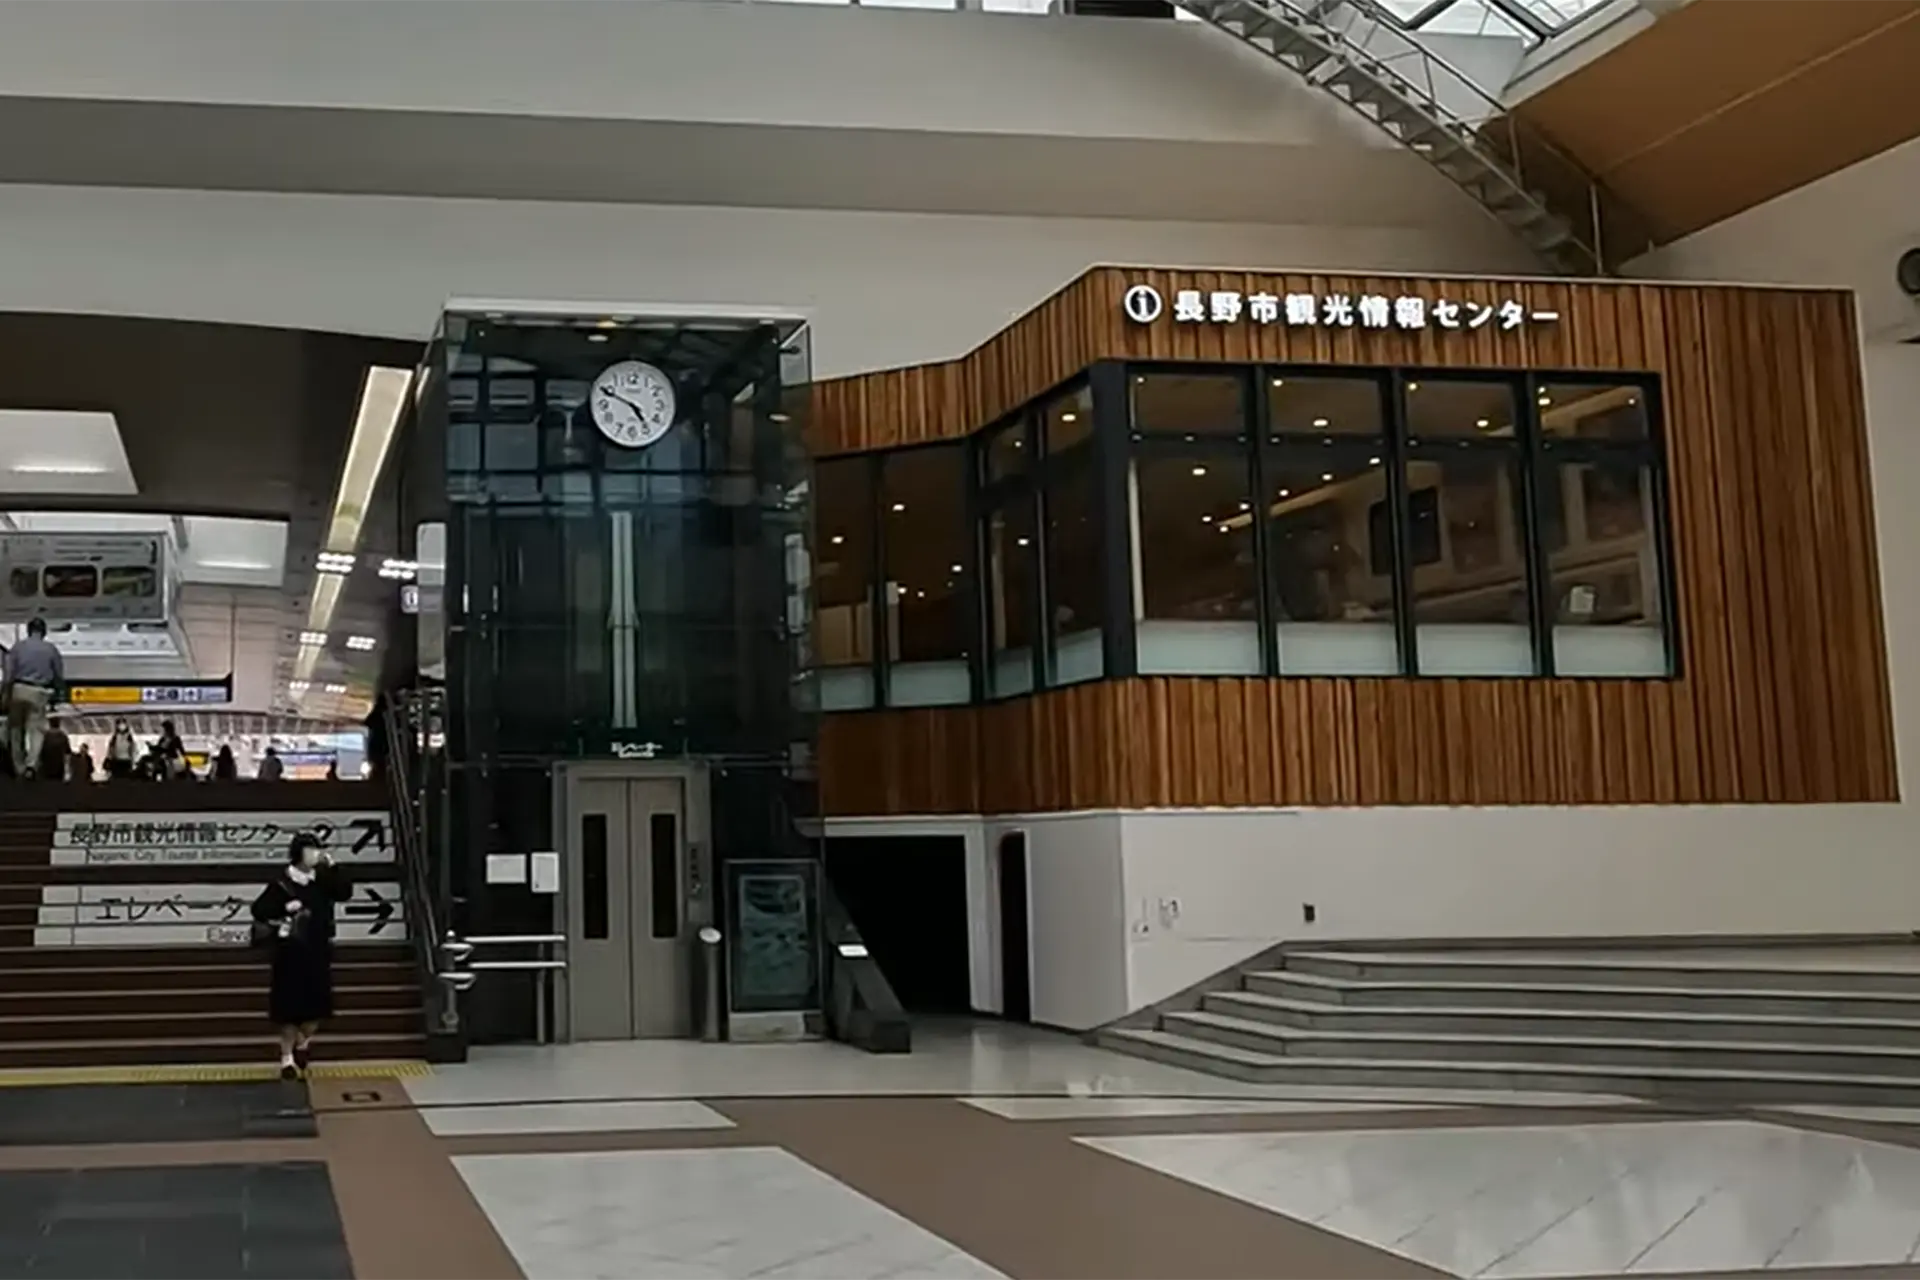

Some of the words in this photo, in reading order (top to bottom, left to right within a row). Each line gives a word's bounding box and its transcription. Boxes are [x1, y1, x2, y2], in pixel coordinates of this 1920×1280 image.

[1174, 290, 1558, 329] 長野市観光情報センター
[96, 894, 243, 921] エレベータ
